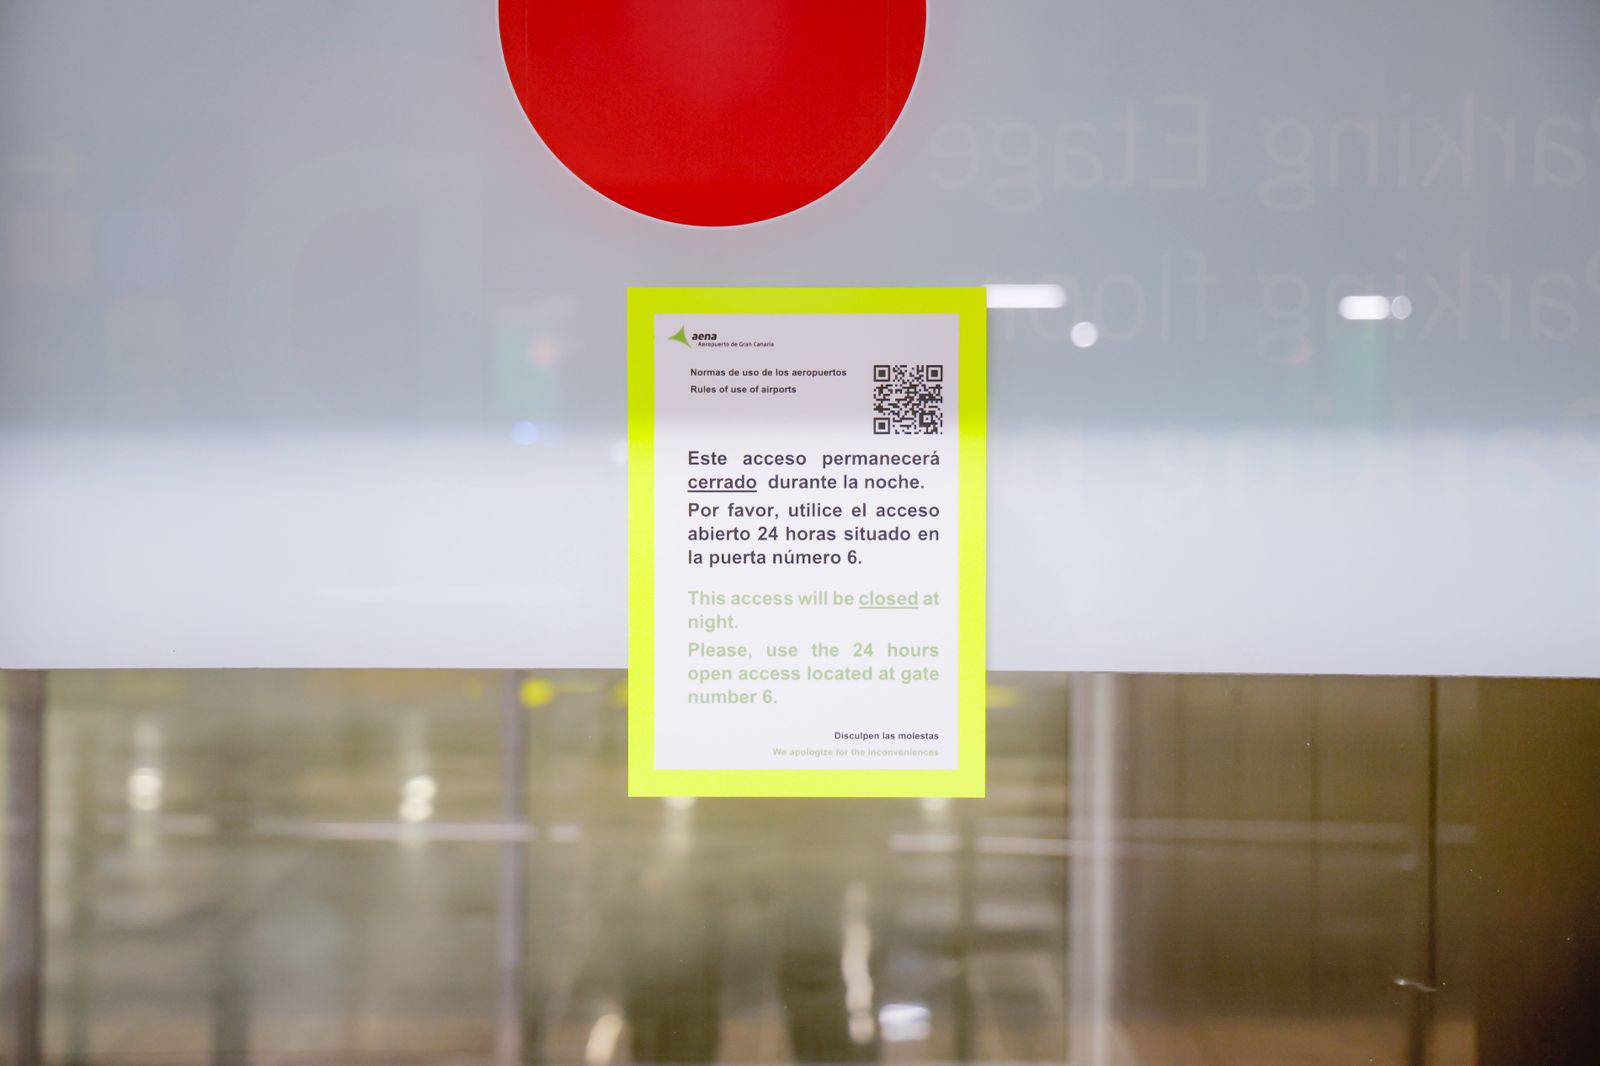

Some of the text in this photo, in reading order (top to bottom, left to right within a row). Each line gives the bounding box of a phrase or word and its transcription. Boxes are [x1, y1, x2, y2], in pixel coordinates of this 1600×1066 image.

[692, 333, 718, 341] aena
[792, 369, 846, 378] aeropuertos
[691, 385, 716, 393] Rules
[719, 385, 728, 393] of
[750, 385, 759, 393] of
[761, 386, 796, 395] airports
[689, 451, 939, 469] Este acceso permanecerá
[687, 475, 924, 492] cerrado durante la noche.
[689, 503, 939, 519] Por favor, utilice el acceso
[688, 526, 939, 541] abierto 24 horas situado en
[689, 550, 861, 568] la puerta número 6.
[688, 591, 939, 609] This access will be closed at
[688, 614, 738, 633] night.
[689, 642, 939, 658] Please, use the 24 hours
[688, 666, 939, 684] open access located at gate
[688, 689, 776, 704] number 6.
[835, 732, 879, 741] Disculpen
[883, 732, 895, 740] las
[773, 748, 787, 756] We
[789, 748, 833, 758] apologize
[836, 748, 848, 756] for
[851, 748, 866, 756] the
